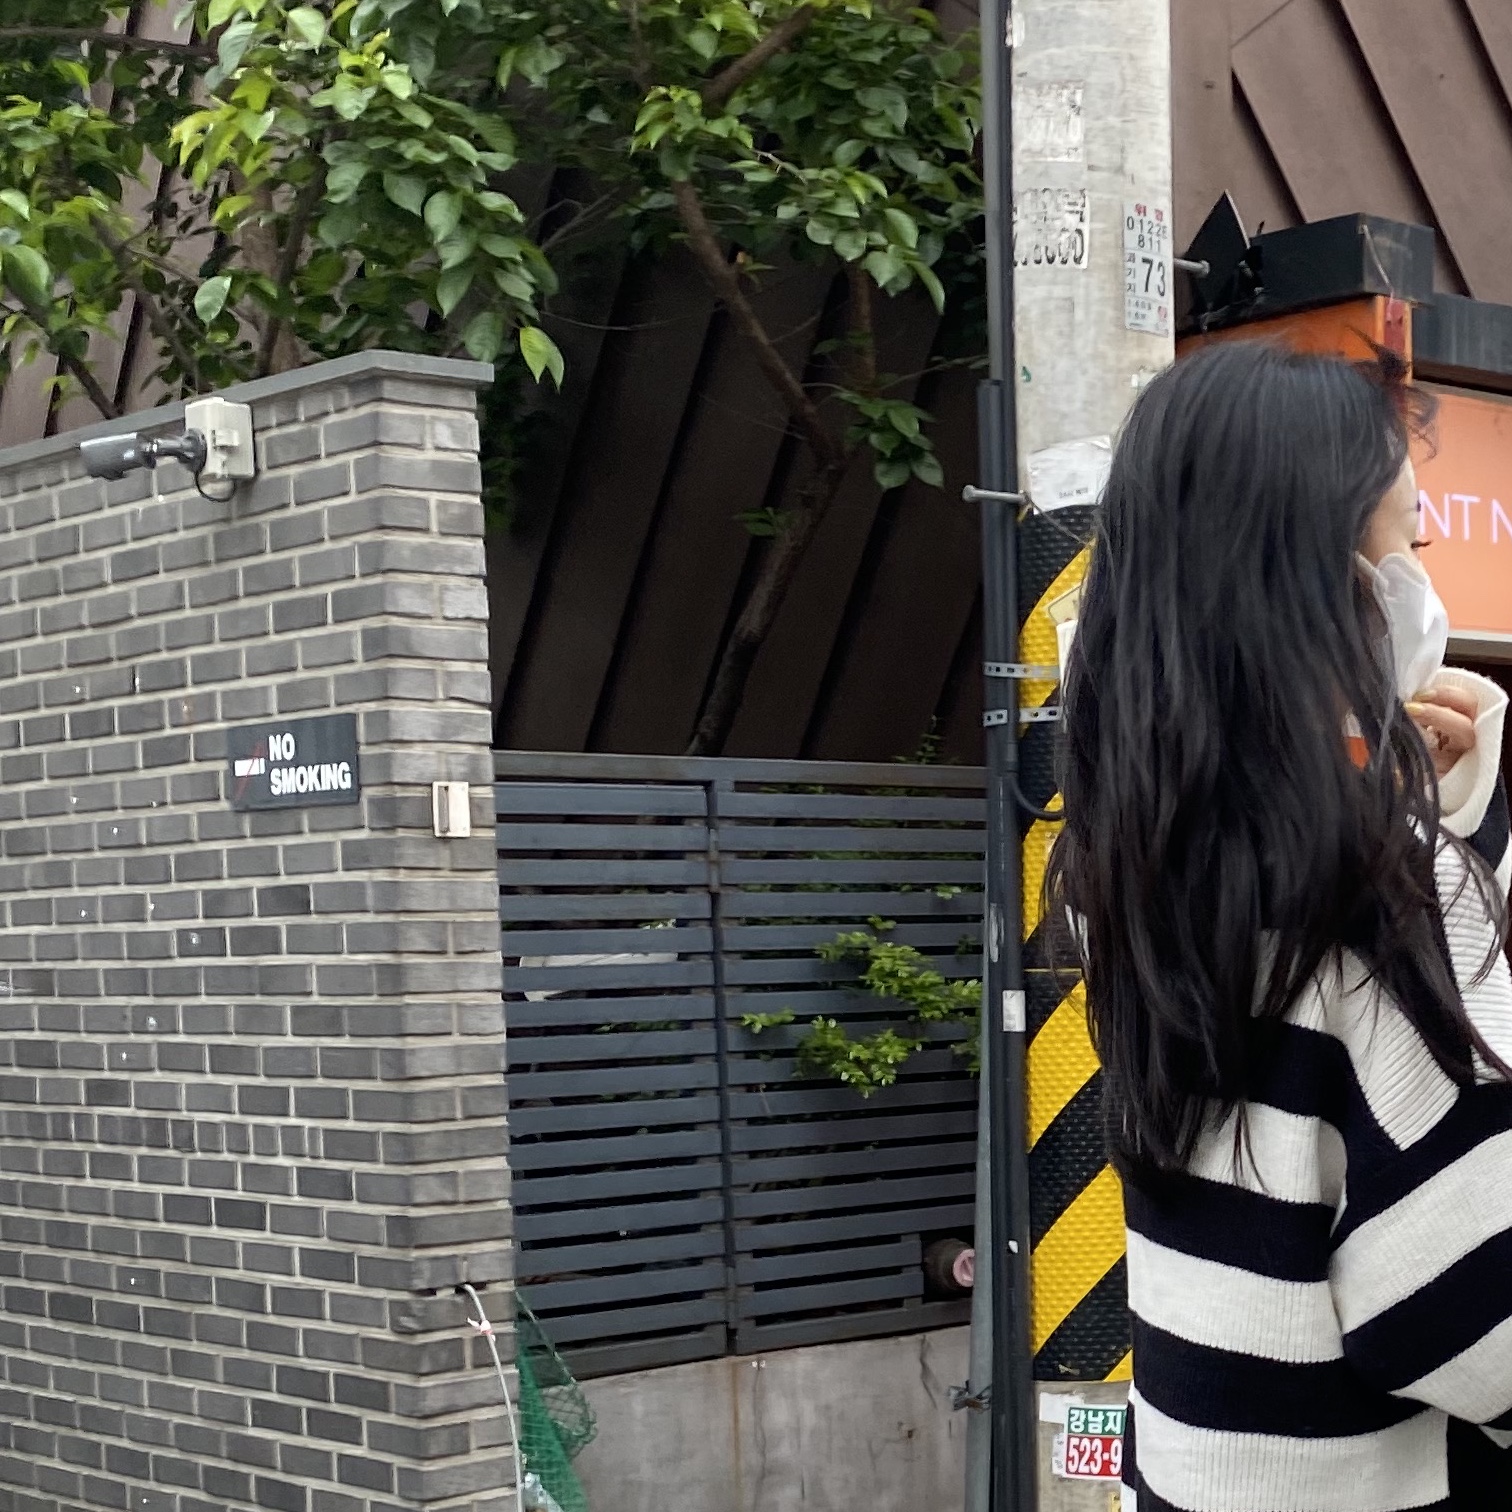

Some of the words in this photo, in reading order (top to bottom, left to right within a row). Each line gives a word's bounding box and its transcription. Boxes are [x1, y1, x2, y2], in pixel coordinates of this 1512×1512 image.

[1141, 257, 1166, 297] 73
[1418, 489, 1481, 541] NT
[269, 733, 296, 761] NO
[270, 762, 352, 796] SMOKING
[1069, 1408, 1122, 1435] 강남지
[1067, 1437, 1122, 1475] 523-9
